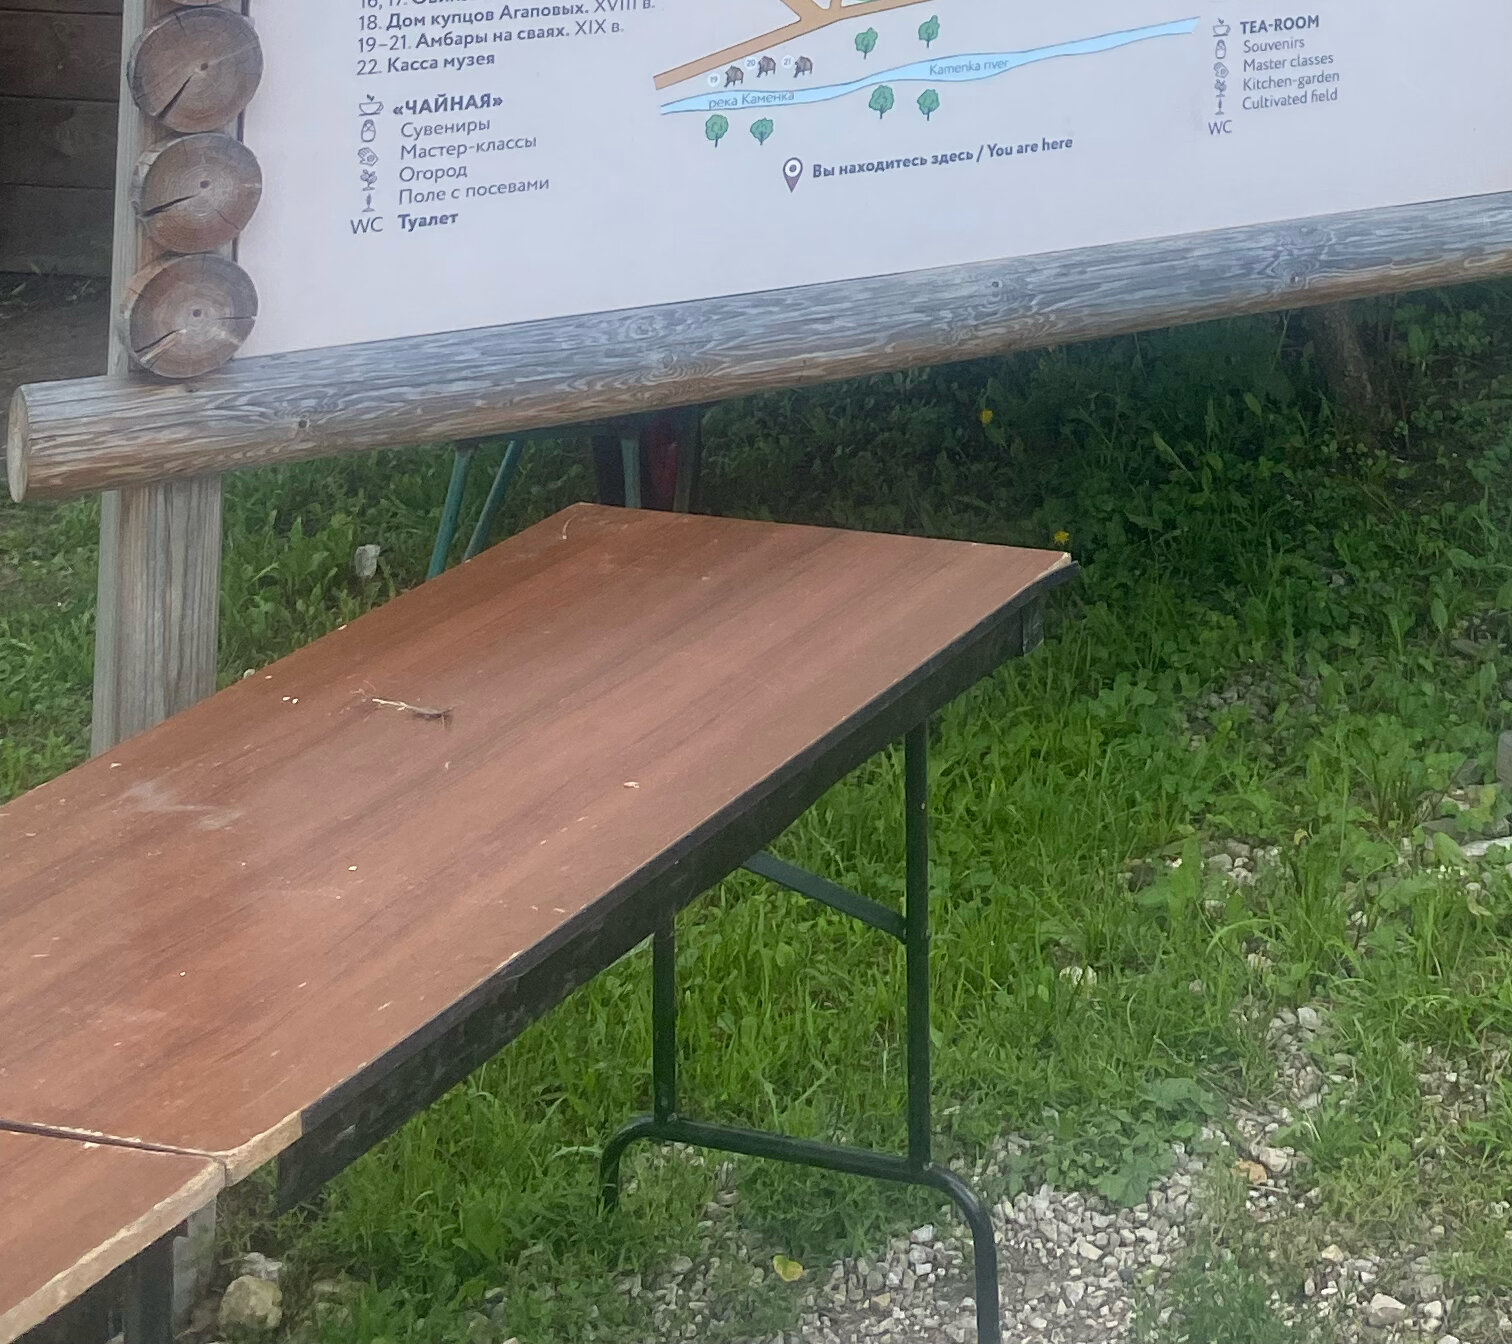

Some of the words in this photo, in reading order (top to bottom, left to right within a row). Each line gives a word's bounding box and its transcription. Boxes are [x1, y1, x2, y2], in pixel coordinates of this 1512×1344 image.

[1239, 15, 1319, 34] TEA-ROOM
[1242, 36, 1305, 53] Souvenirs
[387, 57, 438, 73] Касса
[443, 54, 495, 71] музея
[930, 60, 980, 76] Kamenka
[983, 58, 1009, 72] river
[1243, 58, 1288, 72] Master
[1289, 54, 1334, 67] classes
[1243, 71, 1339, 91] Kitchen-garden
[392, 93, 503, 115] «ЧАЙНАЯ»
[708, 94, 738, 110] река
[741, 91, 795, 105] Каменка
[1241, 90, 1307, 110] Cultivated
[1311, 87, 1338, 103] field
[400, 120, 490, 139] Сувениры
[1208, 119, 1232, 135] WC
[400, 137, 536, 160] Мастер-классы
[812, 164, 835, 178] Вы
[839, 157, 928, 175] находитесь
[930, 151, 973, 165] здесь
[987, 143, 1013, 158] You
[1016, 143, 1038, 154] are
[1041, 137, 1073, 151] here
[399, 166, 468, 182] Огород
[399, 189, 446, 205] Поле
[451, 189, 460, 199] с
[465, 179, 549, 197] посевами
[350, 216, 383, 234] WC
[397, 213, 458, 232] Туалет
